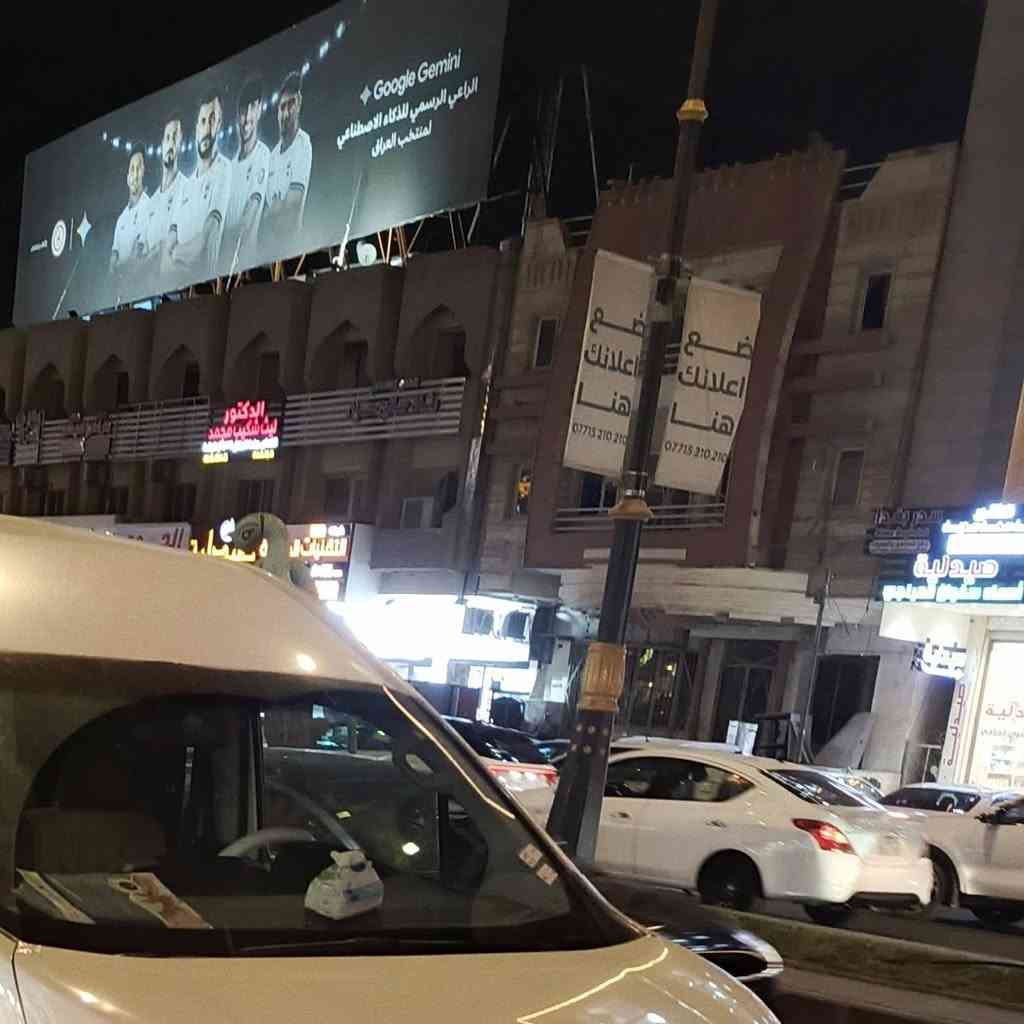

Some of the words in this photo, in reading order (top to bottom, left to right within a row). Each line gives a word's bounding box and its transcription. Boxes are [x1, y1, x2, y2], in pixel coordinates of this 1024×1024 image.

[373, 68, 416, 100] Google
[417, 48, 462, 82] Gemini
[410, 88, 447, 123] الرسمي
[448, 76, 478, 109] الراعي
[382, 102, 409, 126] للذكاء
[337, 111, 382, 150] الاصطناعي
[371, 131, 397, 157] العراق
[397, 119, 432, 148] لمنتخب
[584, 343, 640, 377] اعلانك
[678, 365, 745, 398] اعلانك
[223, 400, 265, 424] الدكتور
[577, 381, 631, 416] هنا
[207, 426, 233, 440] محمد
[233, 418, 260, 440] شكيب
[260, 416, 278, 438] ليث
[670, 401, 734, 436] هنا
[913, 553, 999, 585] صيدلية
[943, 683, 967, 767] صيدلية
[985, 703, 1024, 720] دلية
